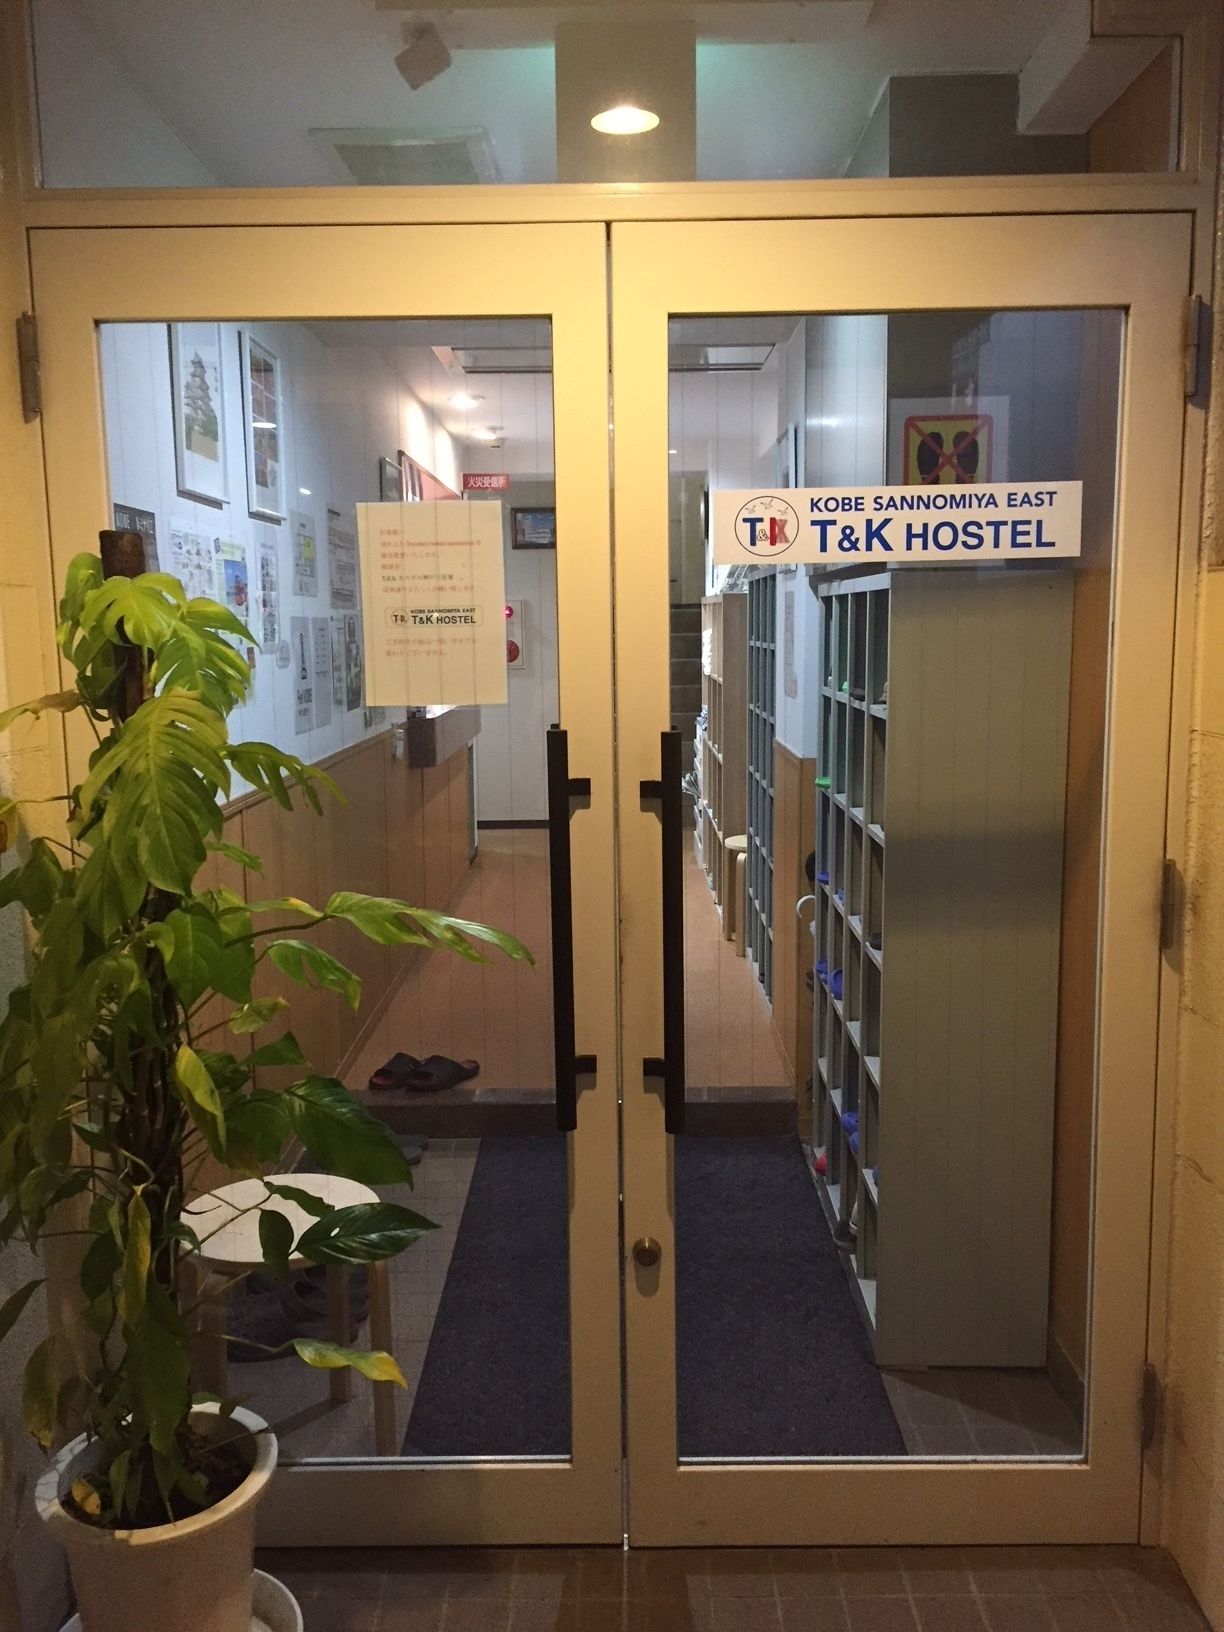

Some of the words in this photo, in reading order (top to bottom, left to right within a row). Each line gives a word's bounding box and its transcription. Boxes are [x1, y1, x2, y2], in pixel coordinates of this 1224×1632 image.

[810, 496, 865, 513] KOBE
[873, 492, 998, 511] SANNOMIYA
[1007, 491, 1057, 508] EAST
[810, 517, 893, 553] T&K
[906, 519, 1056, 551] HOSTEL
[411, 614, 433, 625] T&K
[436, 615, 476, 624] HOSTEL
